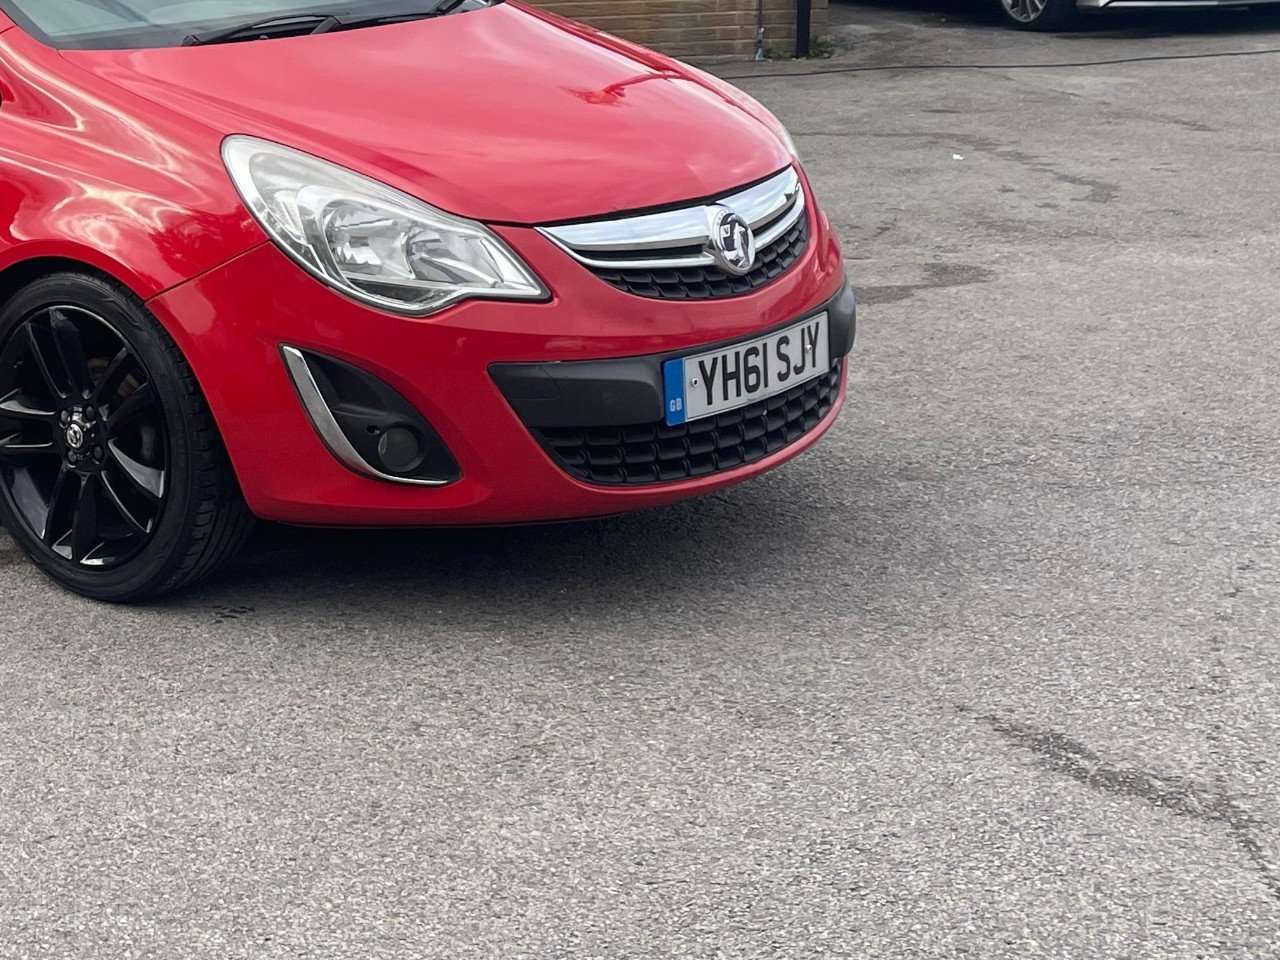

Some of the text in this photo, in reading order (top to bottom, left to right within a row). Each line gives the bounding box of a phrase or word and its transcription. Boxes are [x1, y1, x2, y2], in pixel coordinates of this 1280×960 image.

[698, 322, 820, 406] YH61 SJY
[669, 398, 683, 412] GB
